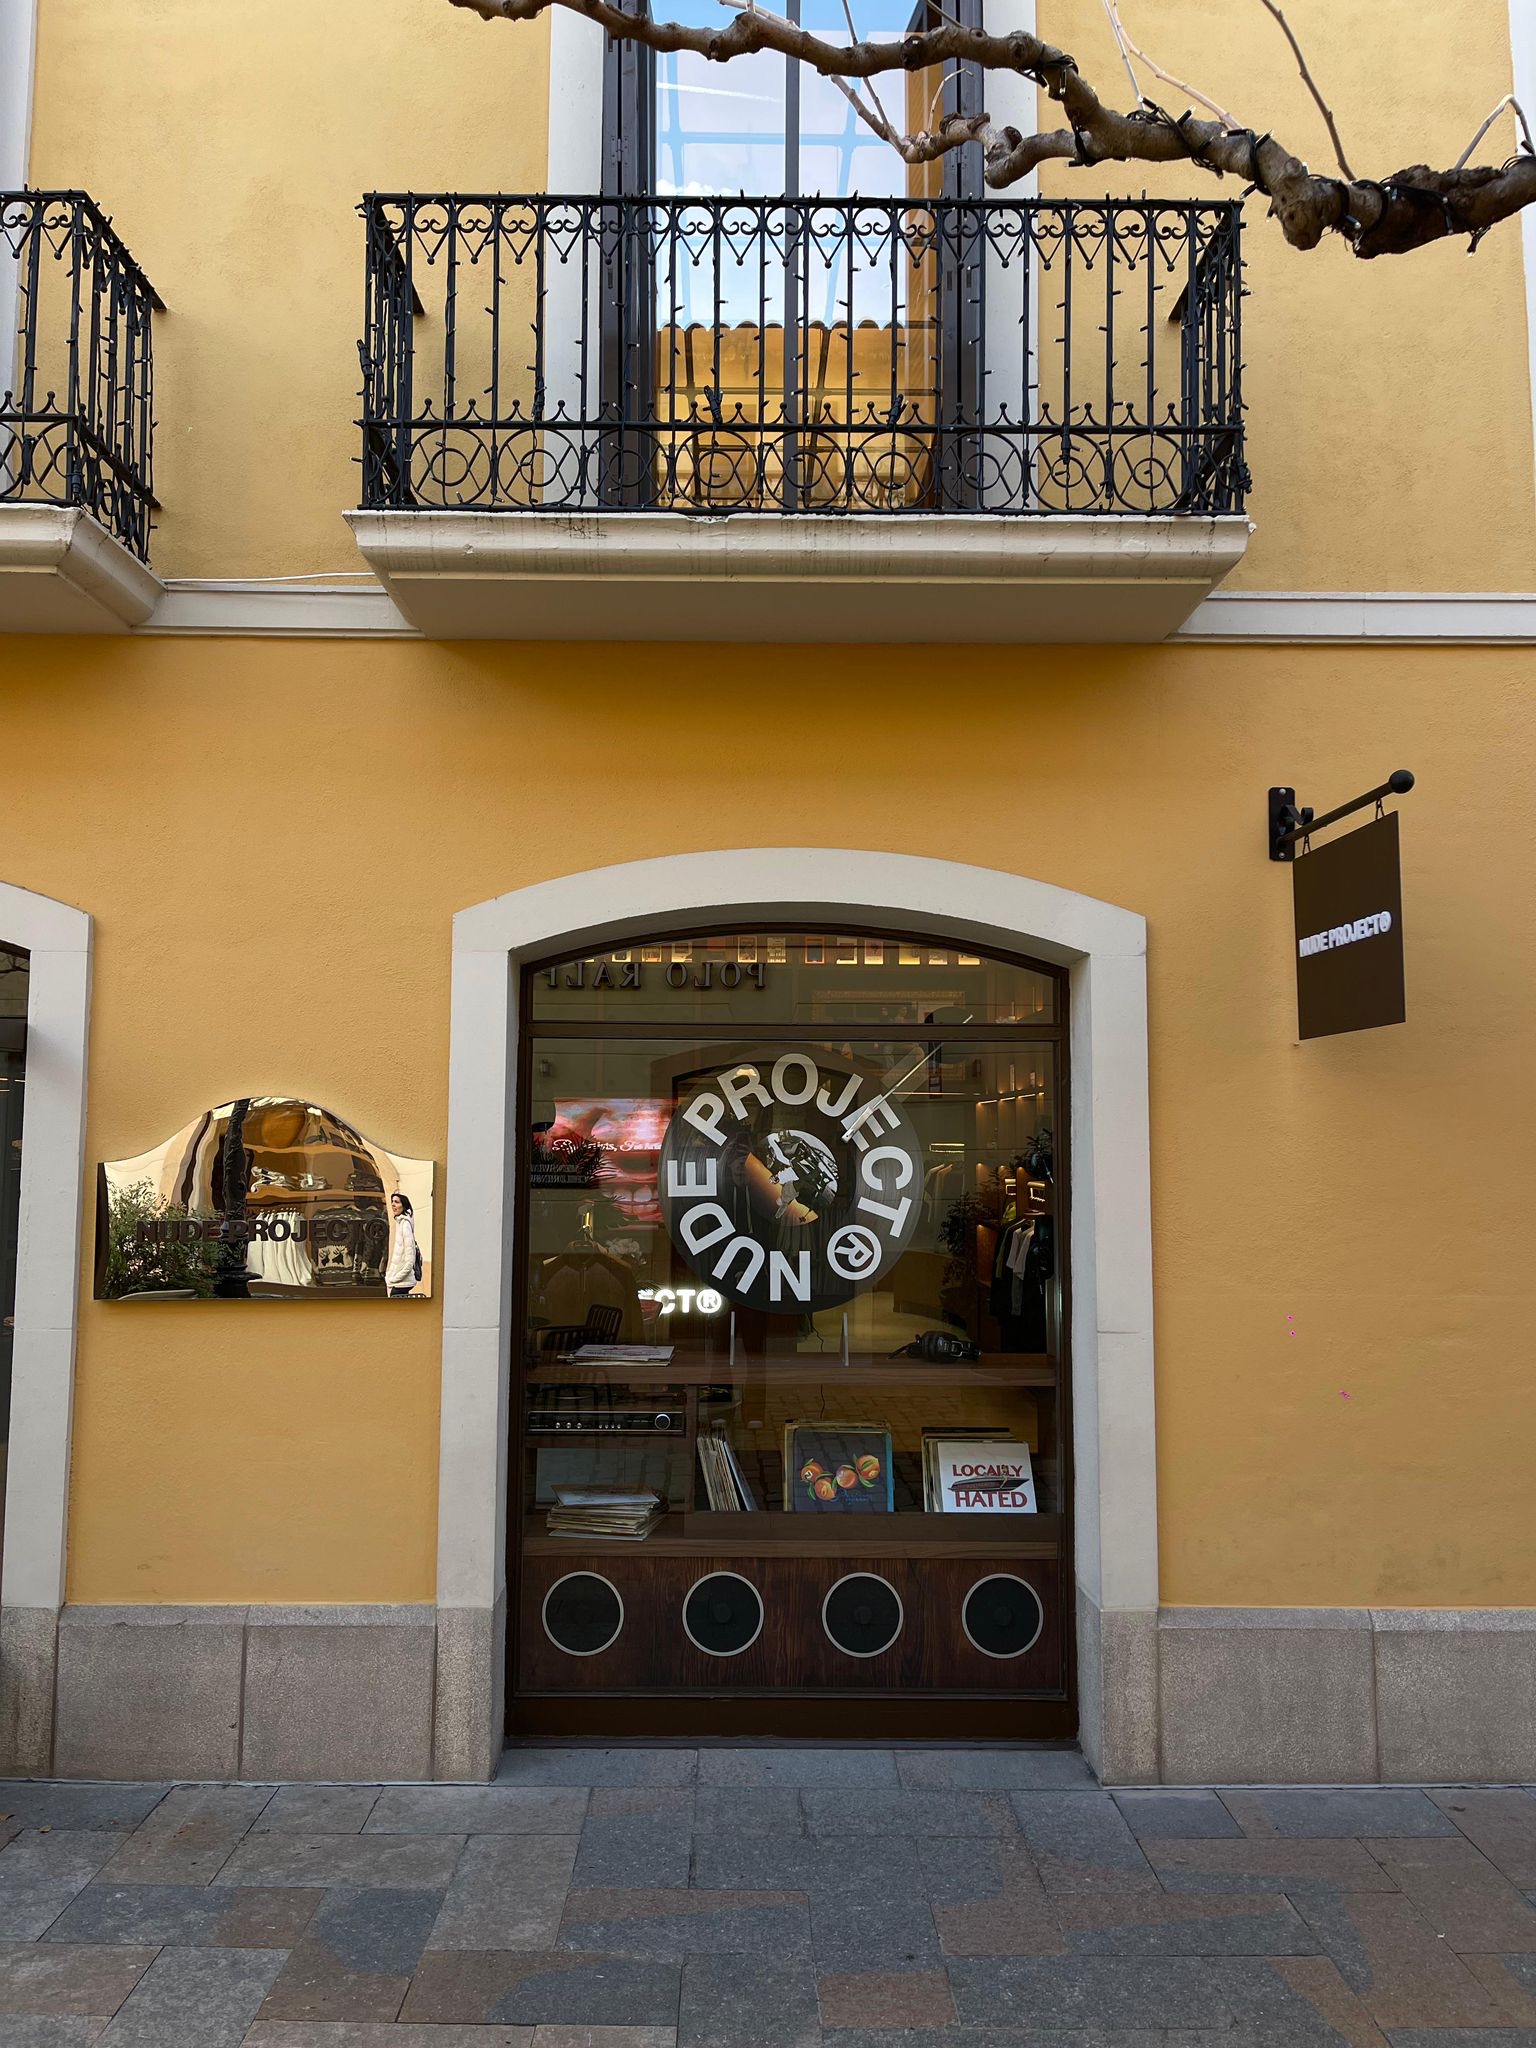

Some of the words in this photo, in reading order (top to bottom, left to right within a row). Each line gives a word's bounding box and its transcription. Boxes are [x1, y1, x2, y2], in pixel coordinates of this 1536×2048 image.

[1299, 931, 1329, 957] NUDE
[136, 1219, 223, 1243] NUDE
[667, 1158, 811, 1301] NUDE
[954, 1491, 1028, 1508] HATED
